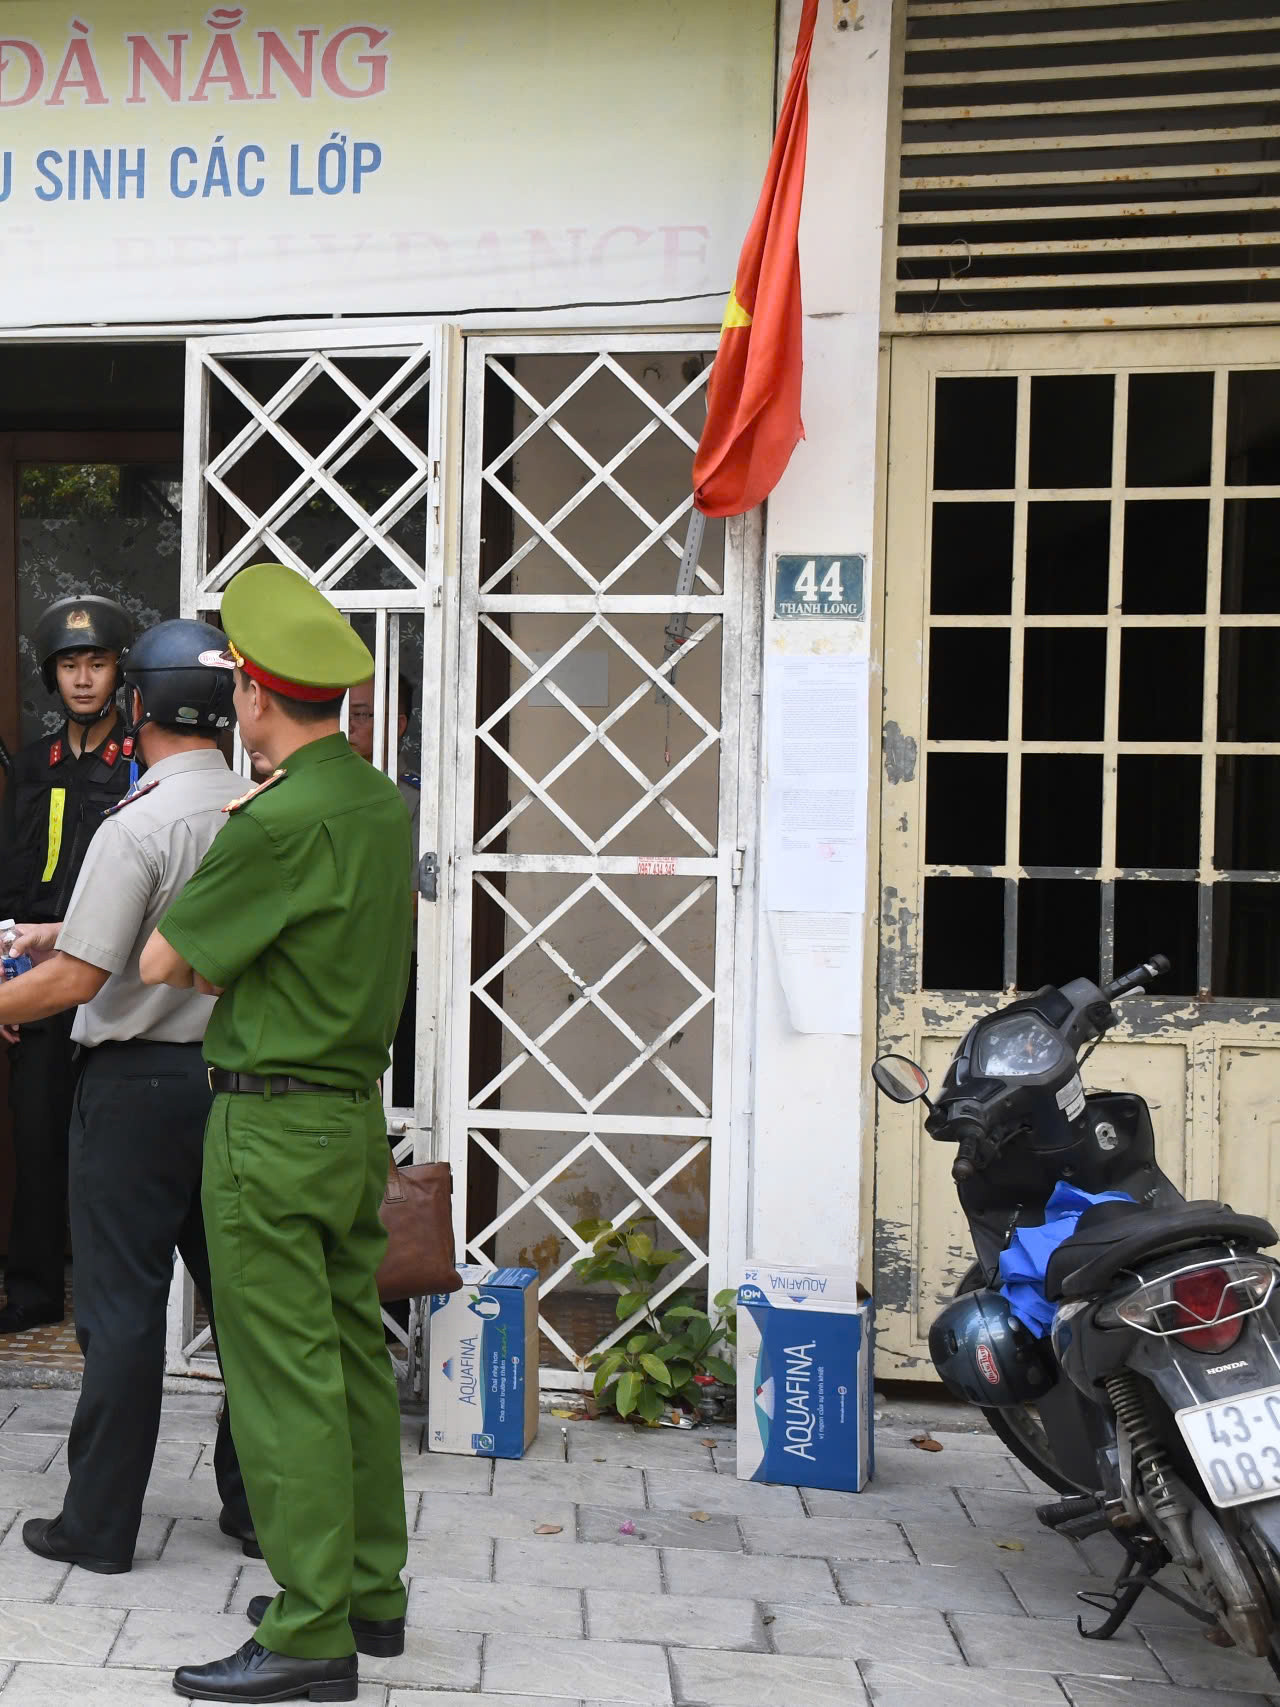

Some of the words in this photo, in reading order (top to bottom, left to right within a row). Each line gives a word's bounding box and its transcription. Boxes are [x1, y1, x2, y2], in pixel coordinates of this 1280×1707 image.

[126, 8, 389, 103] NẴNG
[36, 148, 146, 201] SINH
[169, 135, 267, 198] CÁC
[289, 132, 383, 196] LỚP
[794, 560, 844, 601] 44
[779, 603, 820, 614] THANH
[823, 603, 857, 614] LONG
[745, 1272, 758, 1281] 24
[769, 1274, 828, 1293] AQUAFINA
[458, 1336, 477, 1406] AQUAFINA
[1206, 1360, 1249, 1375] HONDA
[783, 1343, 816, 1461] AQUAFINA
[434, 1430, 443, 1442] 24
